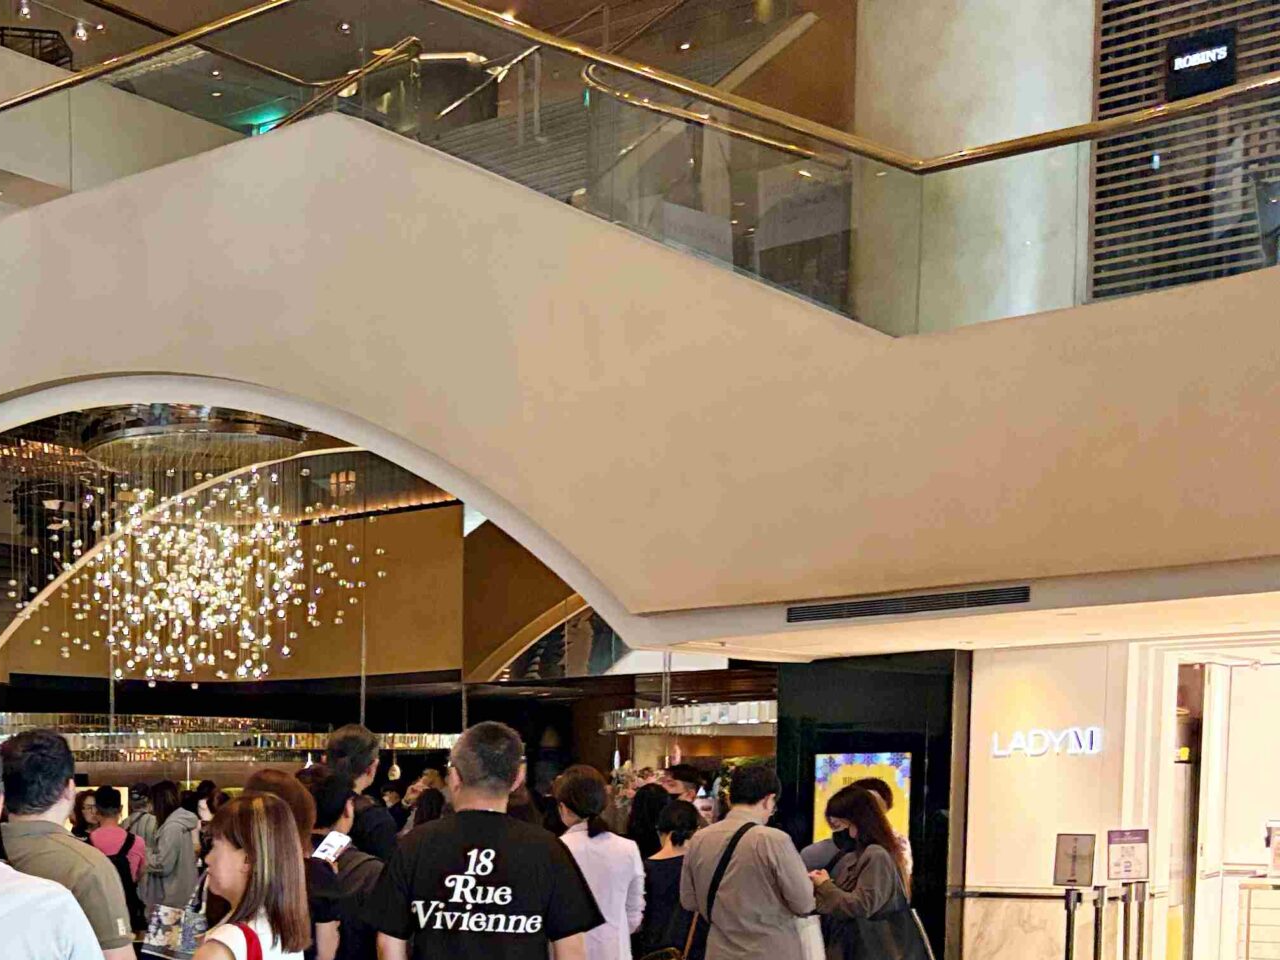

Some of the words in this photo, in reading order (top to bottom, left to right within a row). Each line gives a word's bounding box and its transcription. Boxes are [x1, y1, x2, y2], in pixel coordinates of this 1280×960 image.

[464, 848, 496, 876] 18
[444, 874, 513, 905] Rue
[410, 900, 543, 934] Vivienne
